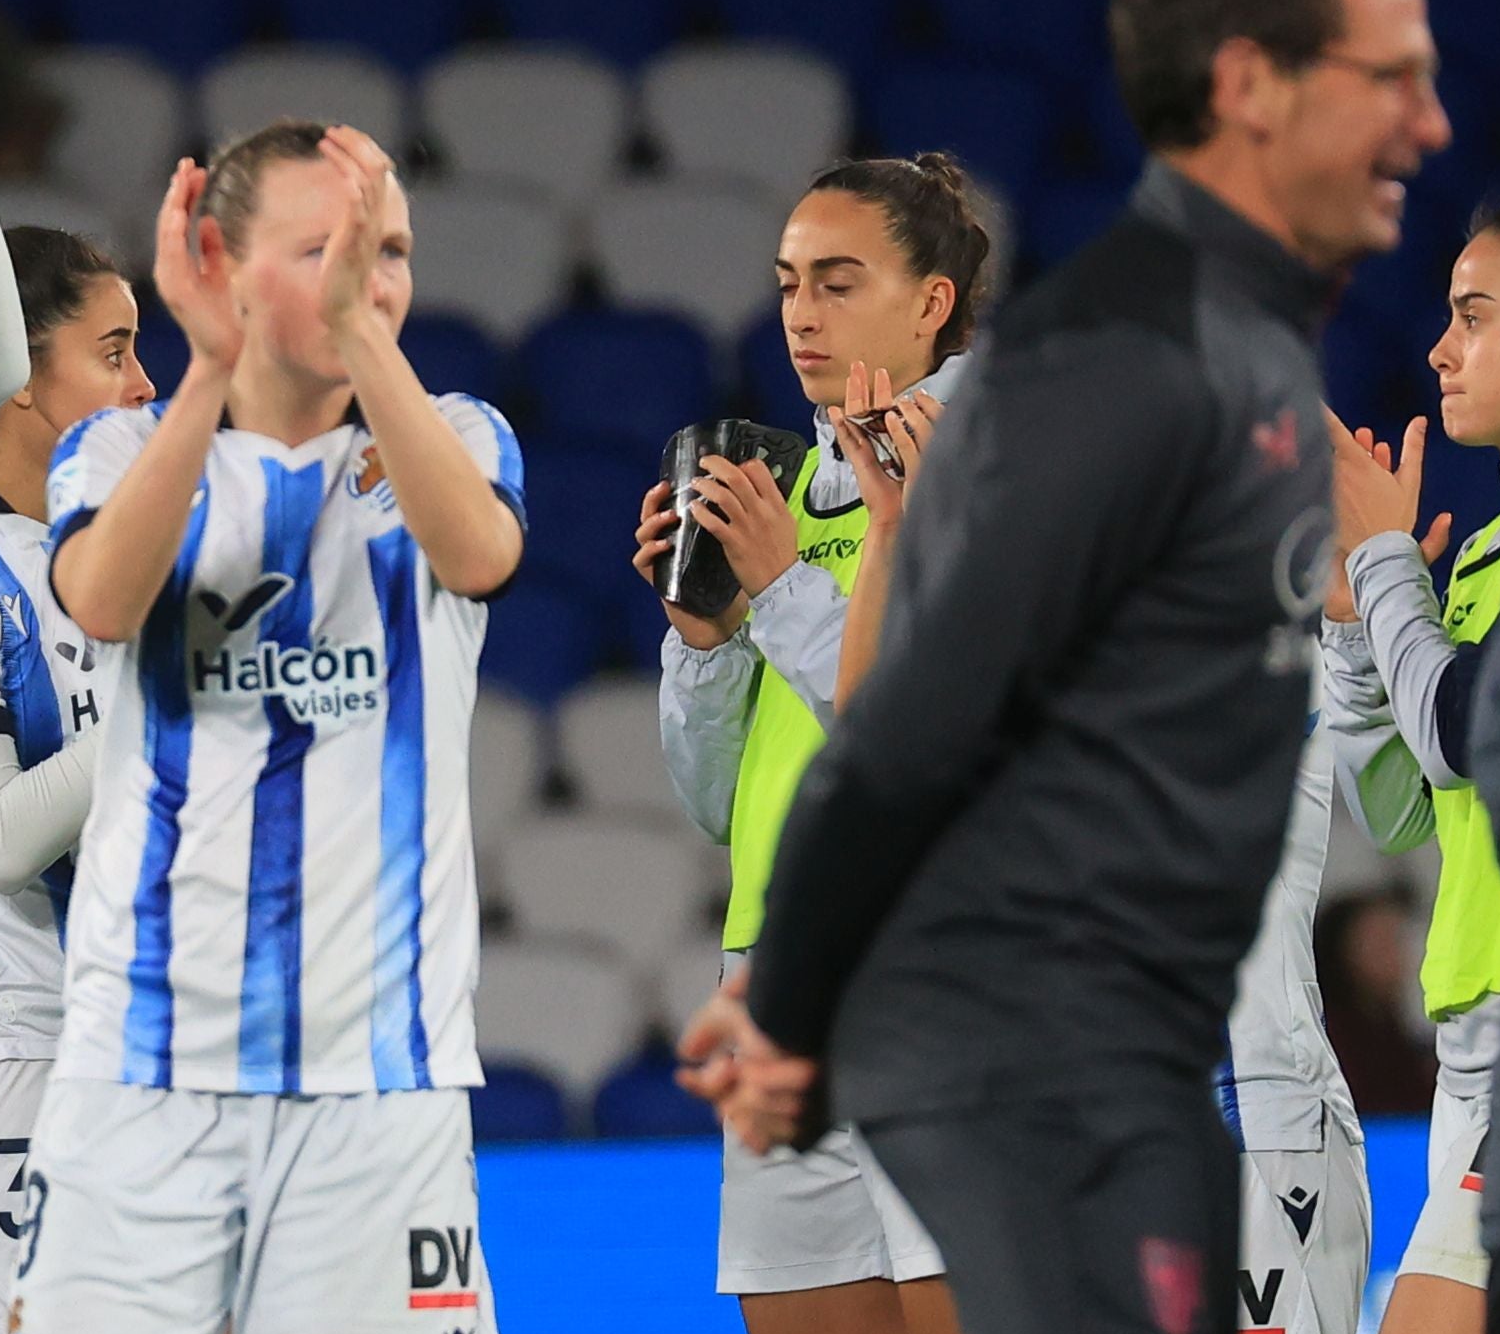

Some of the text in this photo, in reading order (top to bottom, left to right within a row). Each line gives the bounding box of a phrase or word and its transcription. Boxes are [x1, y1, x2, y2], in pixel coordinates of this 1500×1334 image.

[193, 636, 377, 692] Halcón
[293, 689, 378, 718] viajes
[408, 1226, 472, 1290] DV
